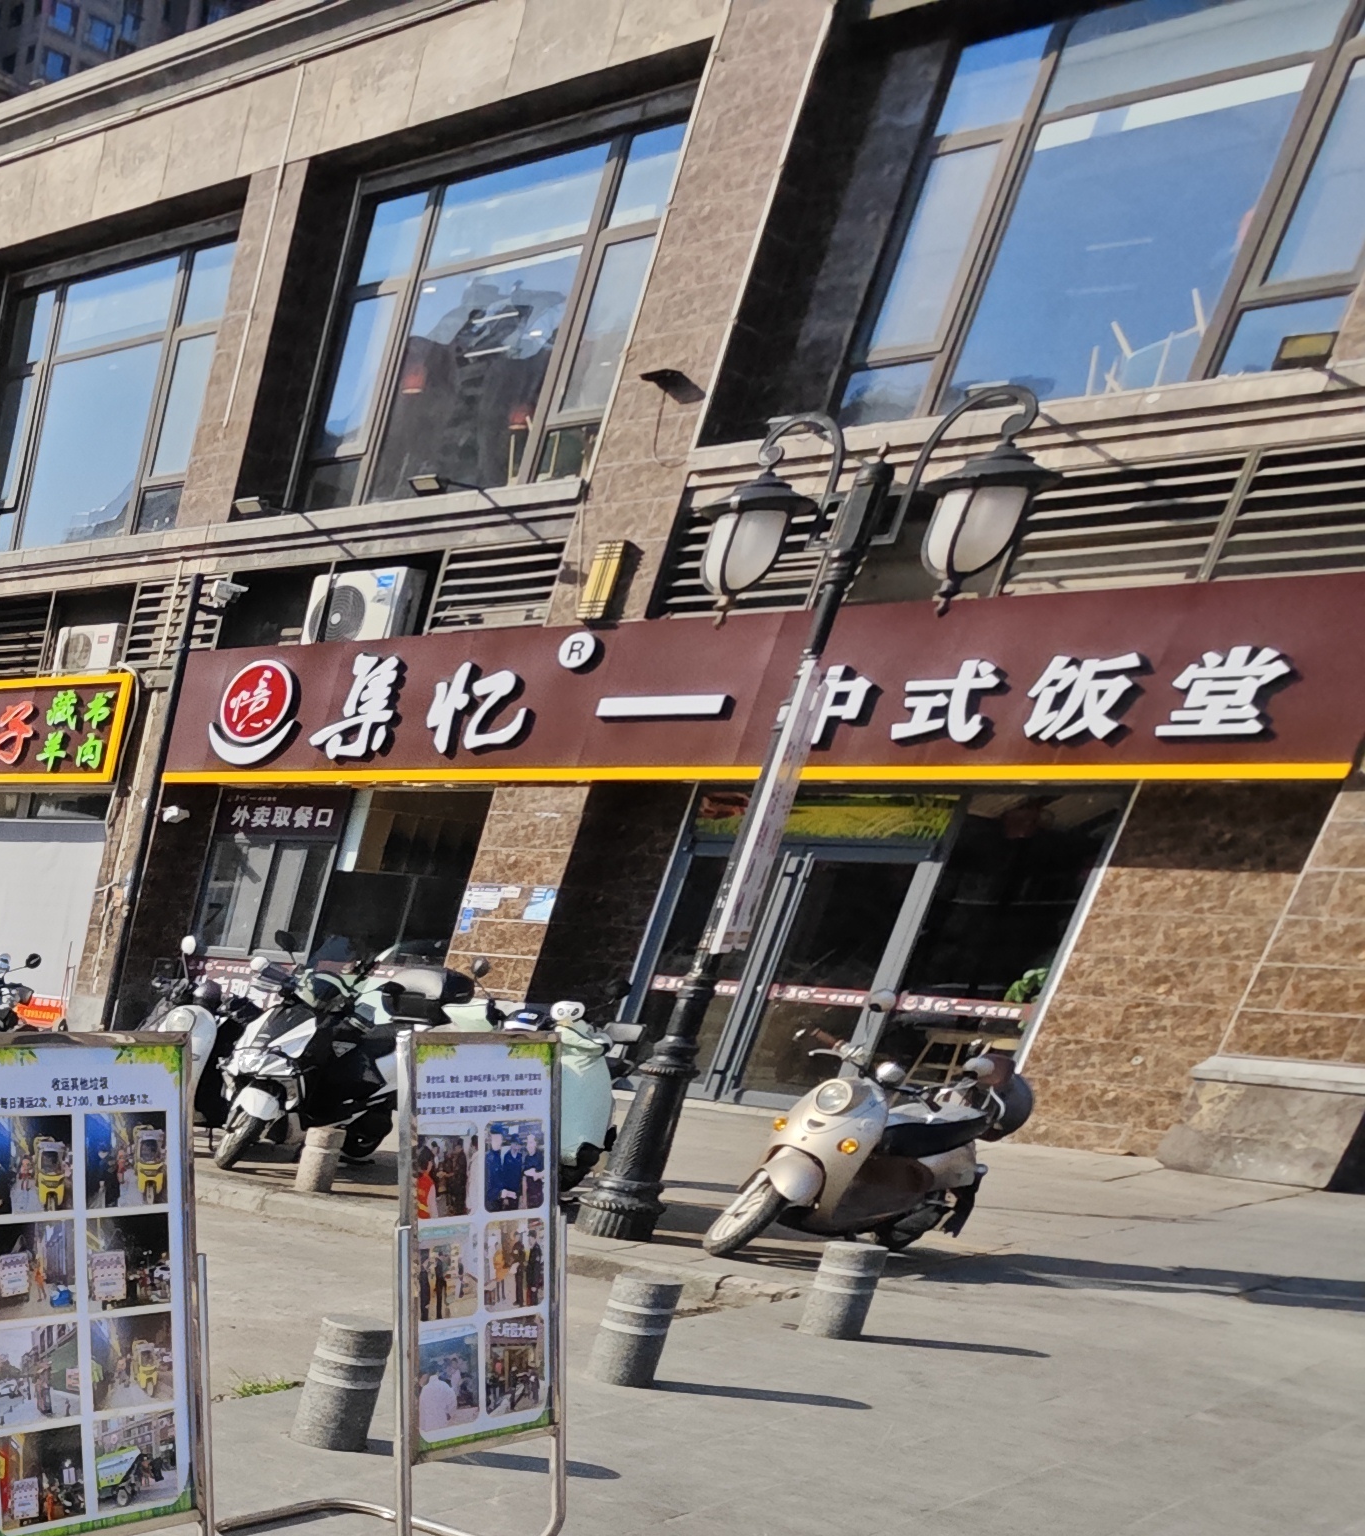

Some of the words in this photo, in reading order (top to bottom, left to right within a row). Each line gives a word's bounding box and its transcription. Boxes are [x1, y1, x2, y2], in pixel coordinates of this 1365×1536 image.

[45, 688, 116, 731] 藏书
[35, 730, 104, 772] 羊肉
[230, 804, 334, 829] 外卖取餐口
[50, 1076, 109, 1092] 收运其他垃圾
